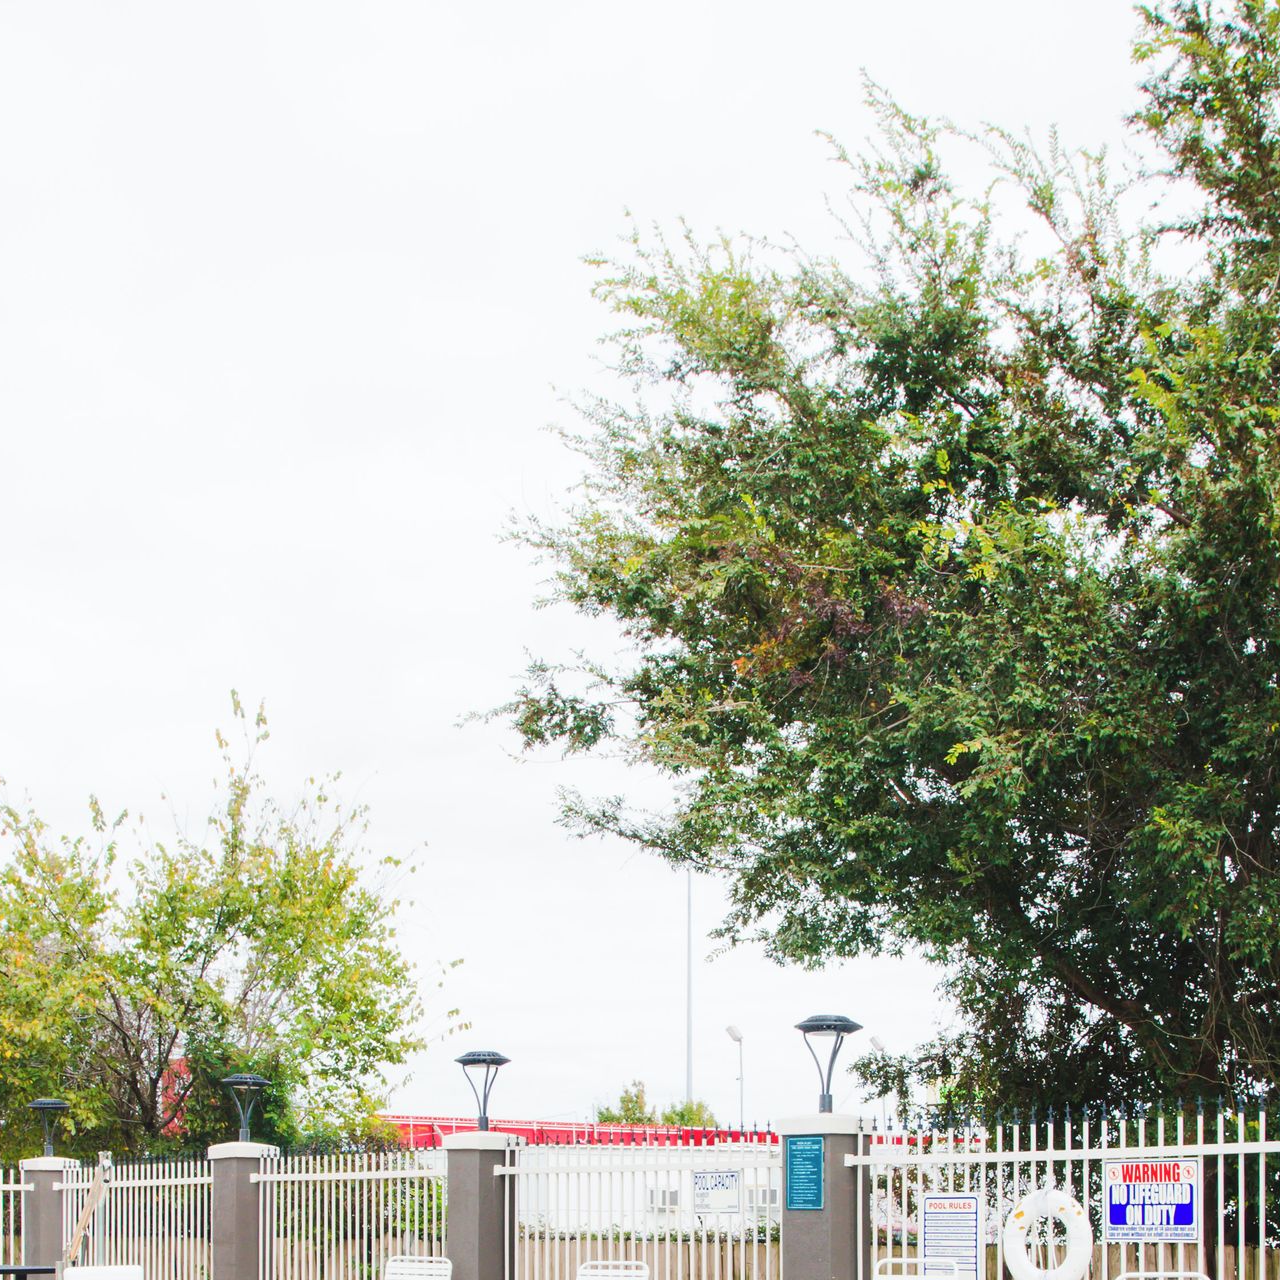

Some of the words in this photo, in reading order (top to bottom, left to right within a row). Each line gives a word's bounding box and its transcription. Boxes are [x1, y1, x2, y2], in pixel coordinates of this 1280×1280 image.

[695, 1175, 709, 1190] POOL
[710, 1174, 738, 1190] CAPACITY
[1121, 1163, 1180, 1183] WARNING
[1112, 1183, 1128, 1205] NO
[1129, 1183, 1191, 1205] LIFEGUARD
[1126, 1205, 1142, 1225] ON
[1144, 1205, 1176, 1225] DUTY
